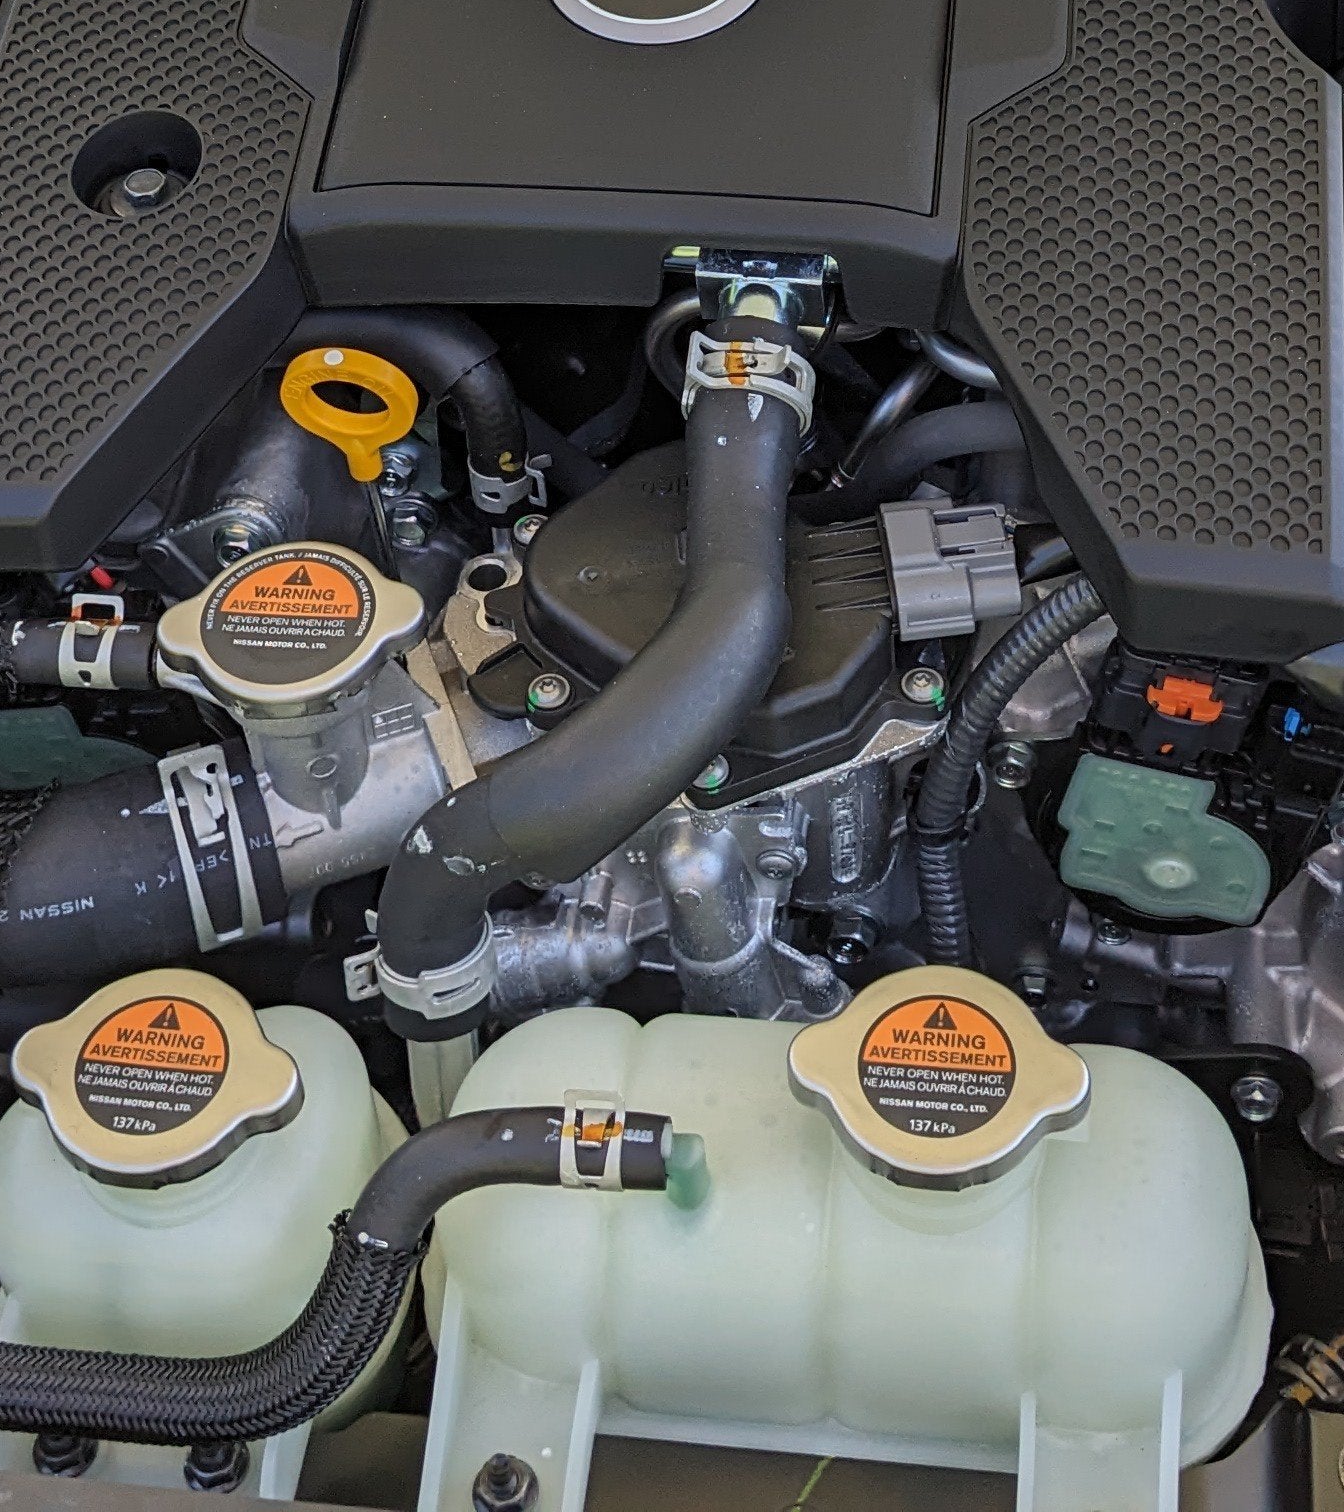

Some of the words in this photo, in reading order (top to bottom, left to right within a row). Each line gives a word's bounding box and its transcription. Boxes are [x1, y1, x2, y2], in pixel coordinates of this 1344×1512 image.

[223, 576, 238, 588] THE
[304, 552, 330, 562] JAMAIS
[362, 592, 371, 601] LE
[254, 585, 336, 601] WARNING
[229, 599, 352, 614] AVERTISSEMENT
[222, 623, 234, 632] NE
[235, 624, 268, 634] JAMAIS
[268, 627, 305, 636] OUVRIR
[310, 629, 346, 637] CHAUD.
[227, 615, 261, 626] NEVER
[261, 616, 290, 626] OPEN
[291, 618, 322, 627] WHEN
[323, 619, 346, 628] HOT.
[233, 638, 263, 647] NISSAN
[264, 640, 294, 648] MOTOR
[312, 642, 328, 650] LTD.
[20, 896, 94, 921] NISSAN
[116, 1028, 206, 1050] WARNING
[892, 1028, 986, 1050] WARNING
[89, 1043, 222, 1068] AVERTISSEMENT
[869, 1045, 1007, 1068] AVERTISSEMENT
[84, 1062, 121, 1076] NEVER
[122, 1067, 153, 1079] OPEN
[155, 1070, 189, 1083] WHEN
[189, 1074, 214, 1085] HOT.
[867, 1065, 905, 1078] NEVER
[907, 1068, 939, 1081] OPEN
[941, 1071, 977, 1083] WHEN
[979, 1074, 1005, 1085] HOT.
[77, 1074, 92, 1085] NE
[92, 1075, 129, 1089] JAMAIS
[129, 1080, 168, 1092] OUVRIR
[175, 1084, 213, 1096] CHAUD.
[863, 1077, 878, 1088] NE
[878, 1078, 916, 1091] JAMAIS
[917, 1081, 957, 1094] OUVRIR
[966, 1085, 1007, 1097] CHAUD.
[88, 1094, 122, 1107] NISSAN
[123, 1098, 155, 1109] MOTOR
[175, 1103, 192, 1112] LTD.
[879, 1097, 914, 1108] NISSAN
[915, 1100, 949, 1110] MOTOR
[970, 1104, 989, 1113] LTD.
